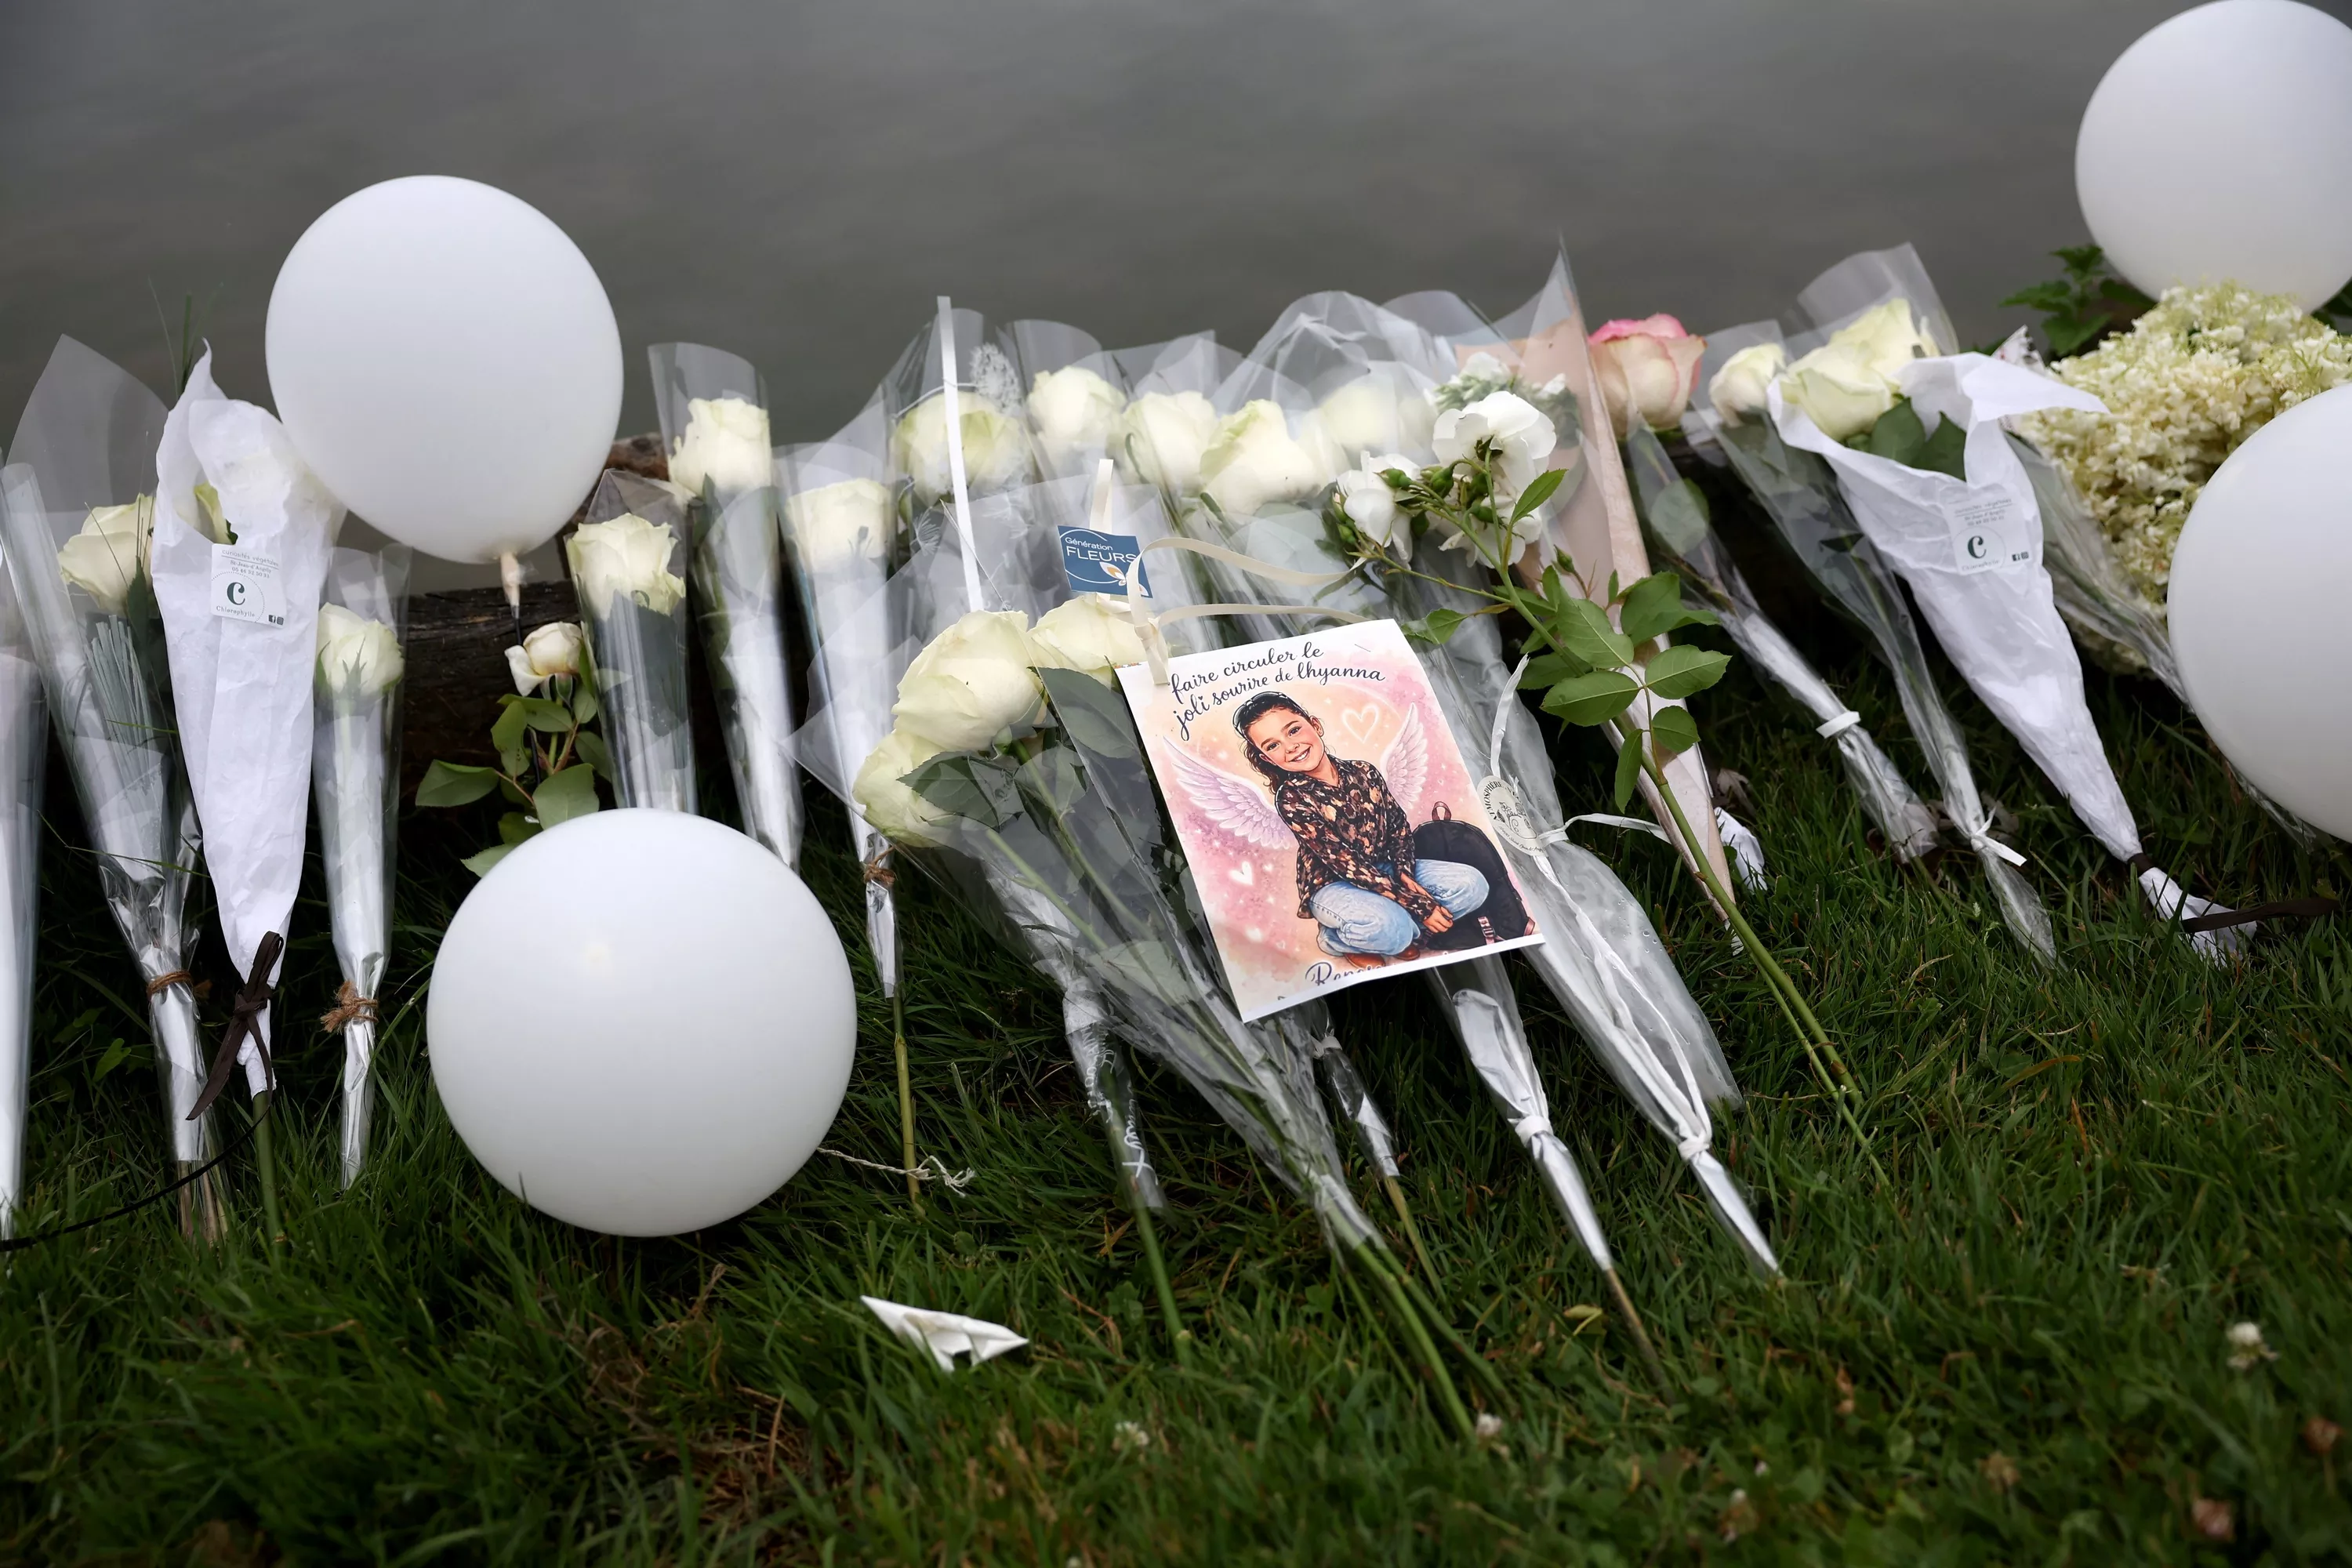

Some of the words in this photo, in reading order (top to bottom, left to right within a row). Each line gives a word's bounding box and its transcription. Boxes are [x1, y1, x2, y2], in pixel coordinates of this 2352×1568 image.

[1065, 536, 1113, 551] Génération
[1065, 546, 1137, 564] FLEURS
[216, 605, 256, 618] Chlorophylle
[1168, 673, 1218, 704] faire
[1223, 648, 1298, 677] circuler
[1301, 641, 1324, 659] le
[1173, 694, 1210, 741] joli
[1212, 677, 1269, 706] sourire
[1275, 667, 1294, 683] de
